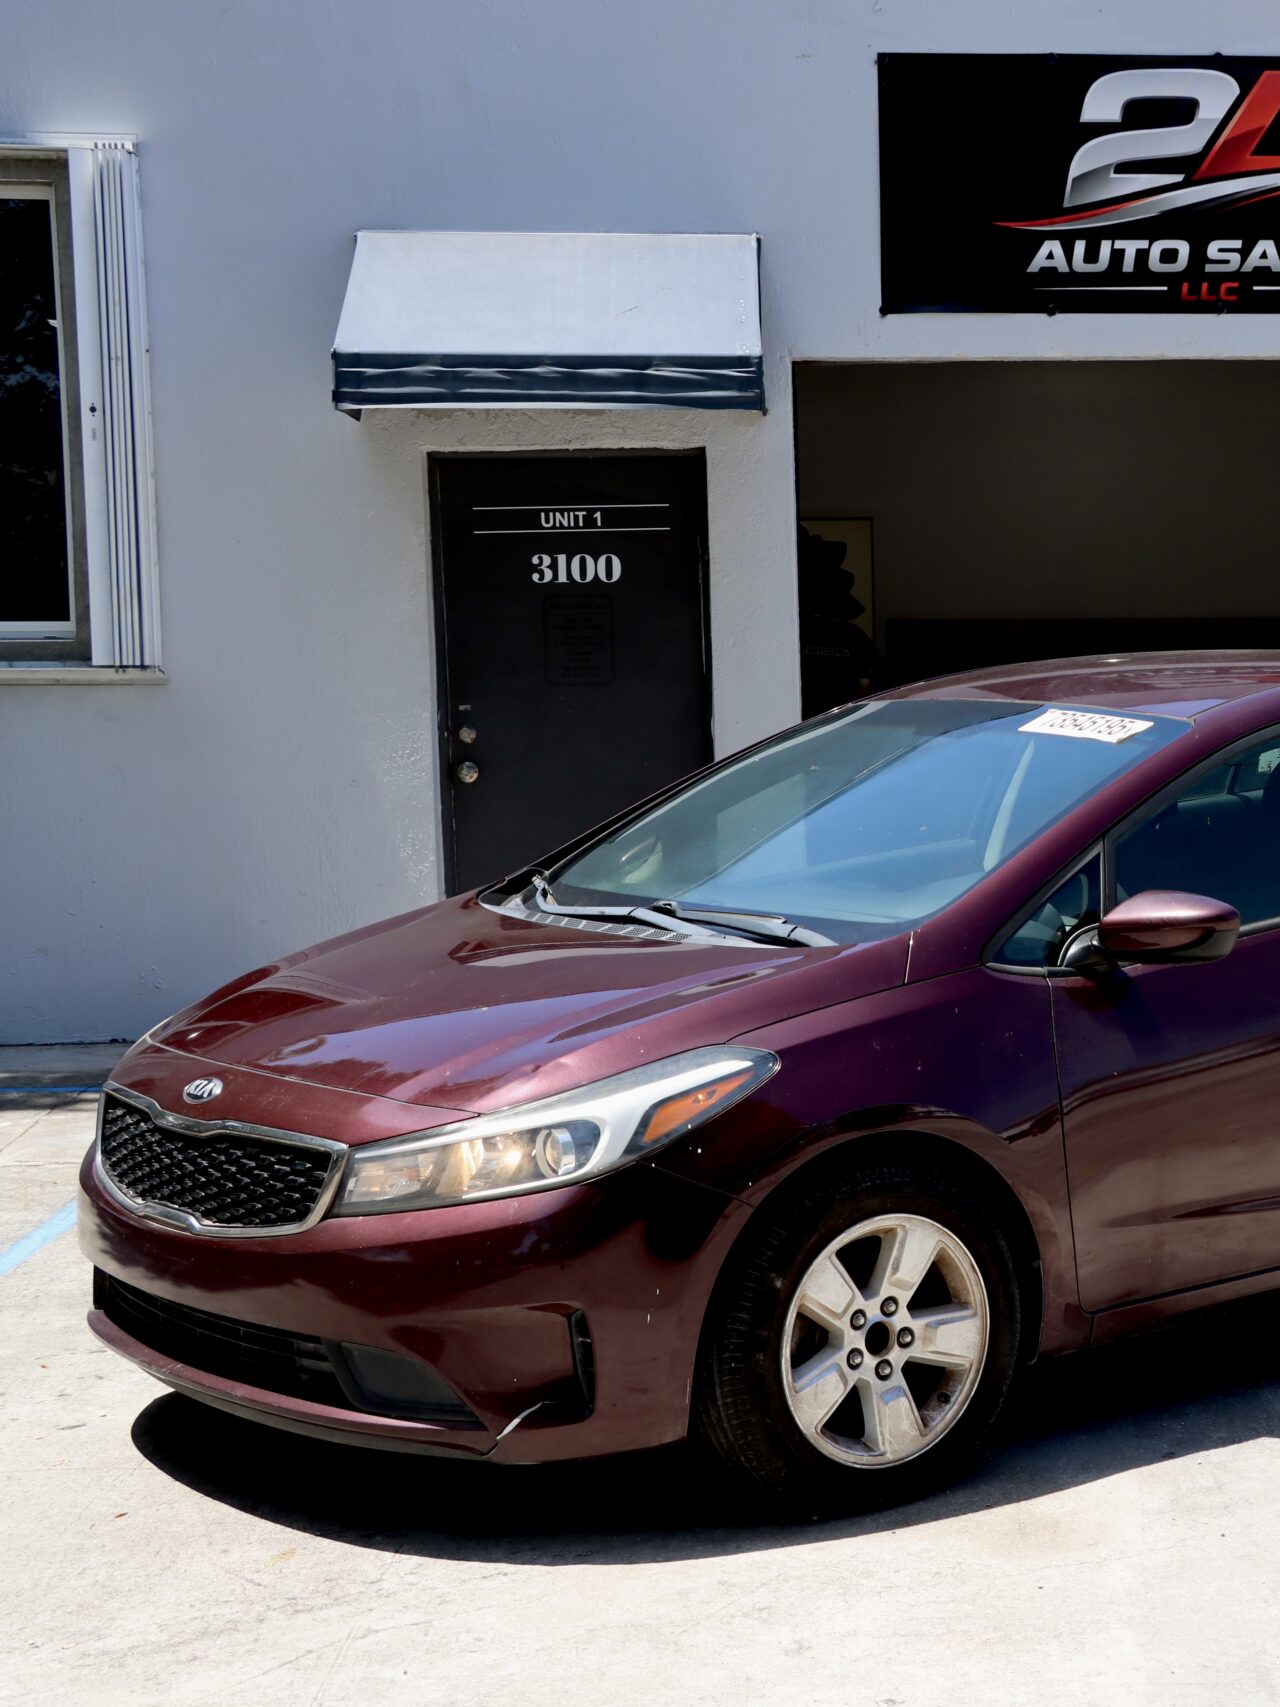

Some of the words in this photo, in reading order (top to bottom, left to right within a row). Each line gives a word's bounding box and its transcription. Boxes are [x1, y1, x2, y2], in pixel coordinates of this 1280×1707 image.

[1026, 240, 1190, 273] AUTO
[1181, 282, 1240, 300] LLC
[540, 511, 587, 528] UNIT
[593, 511, 602, 527] 1
[531, 553, 622, 583] 3100
